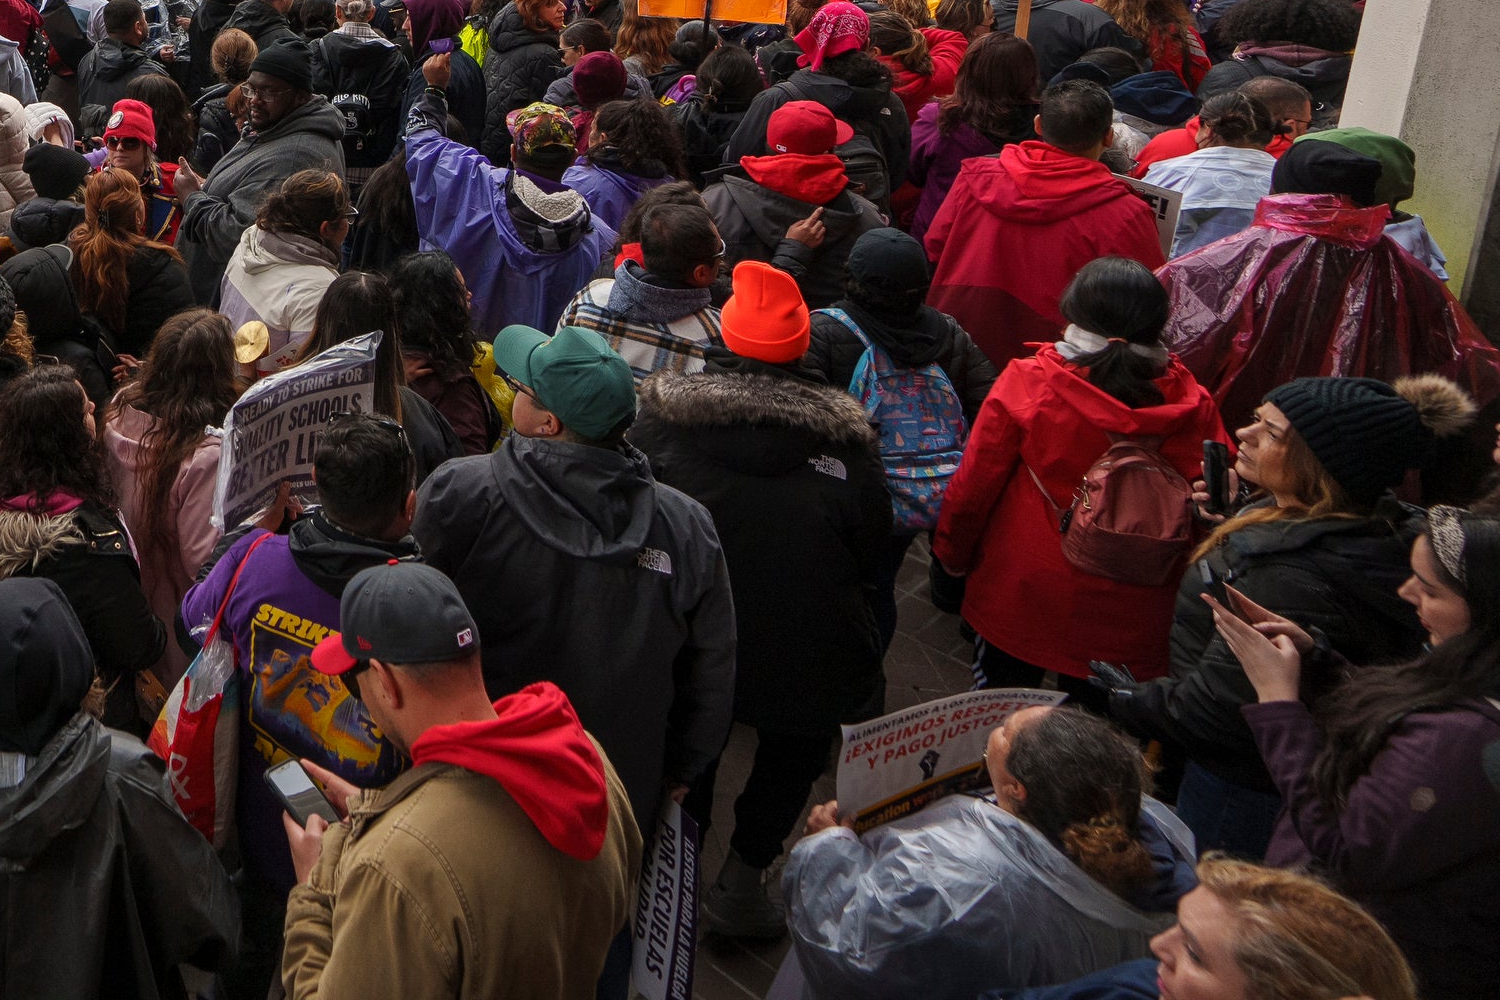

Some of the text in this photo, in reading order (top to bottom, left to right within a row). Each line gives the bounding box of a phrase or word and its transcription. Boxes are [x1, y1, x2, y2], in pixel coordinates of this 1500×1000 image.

[242, 367, 363, 425] READY TO STRIKE FOR
[228, 439, 290, 500] BETTER
[808, 458, 835, 469] NORTH
[815, 465, 835, 476] FACE
[821, 454, 836, 464] THE
[848, 709, 930, 743] ALIMENTAMOS
[943, 699, 965, 711] LOS
[966, 692, 1056, 704] ESTUDIANTES
[845, 716, 947, 764] ¡EXIGIMOS
[867, 756, 878, 769] Y
[883, 733, 936, 764] PAGO
[645, 819, 676, 981] POR ESCUELAS
[680, 888, 693, 930] PARA
[678, 929, 692, 949] LA
